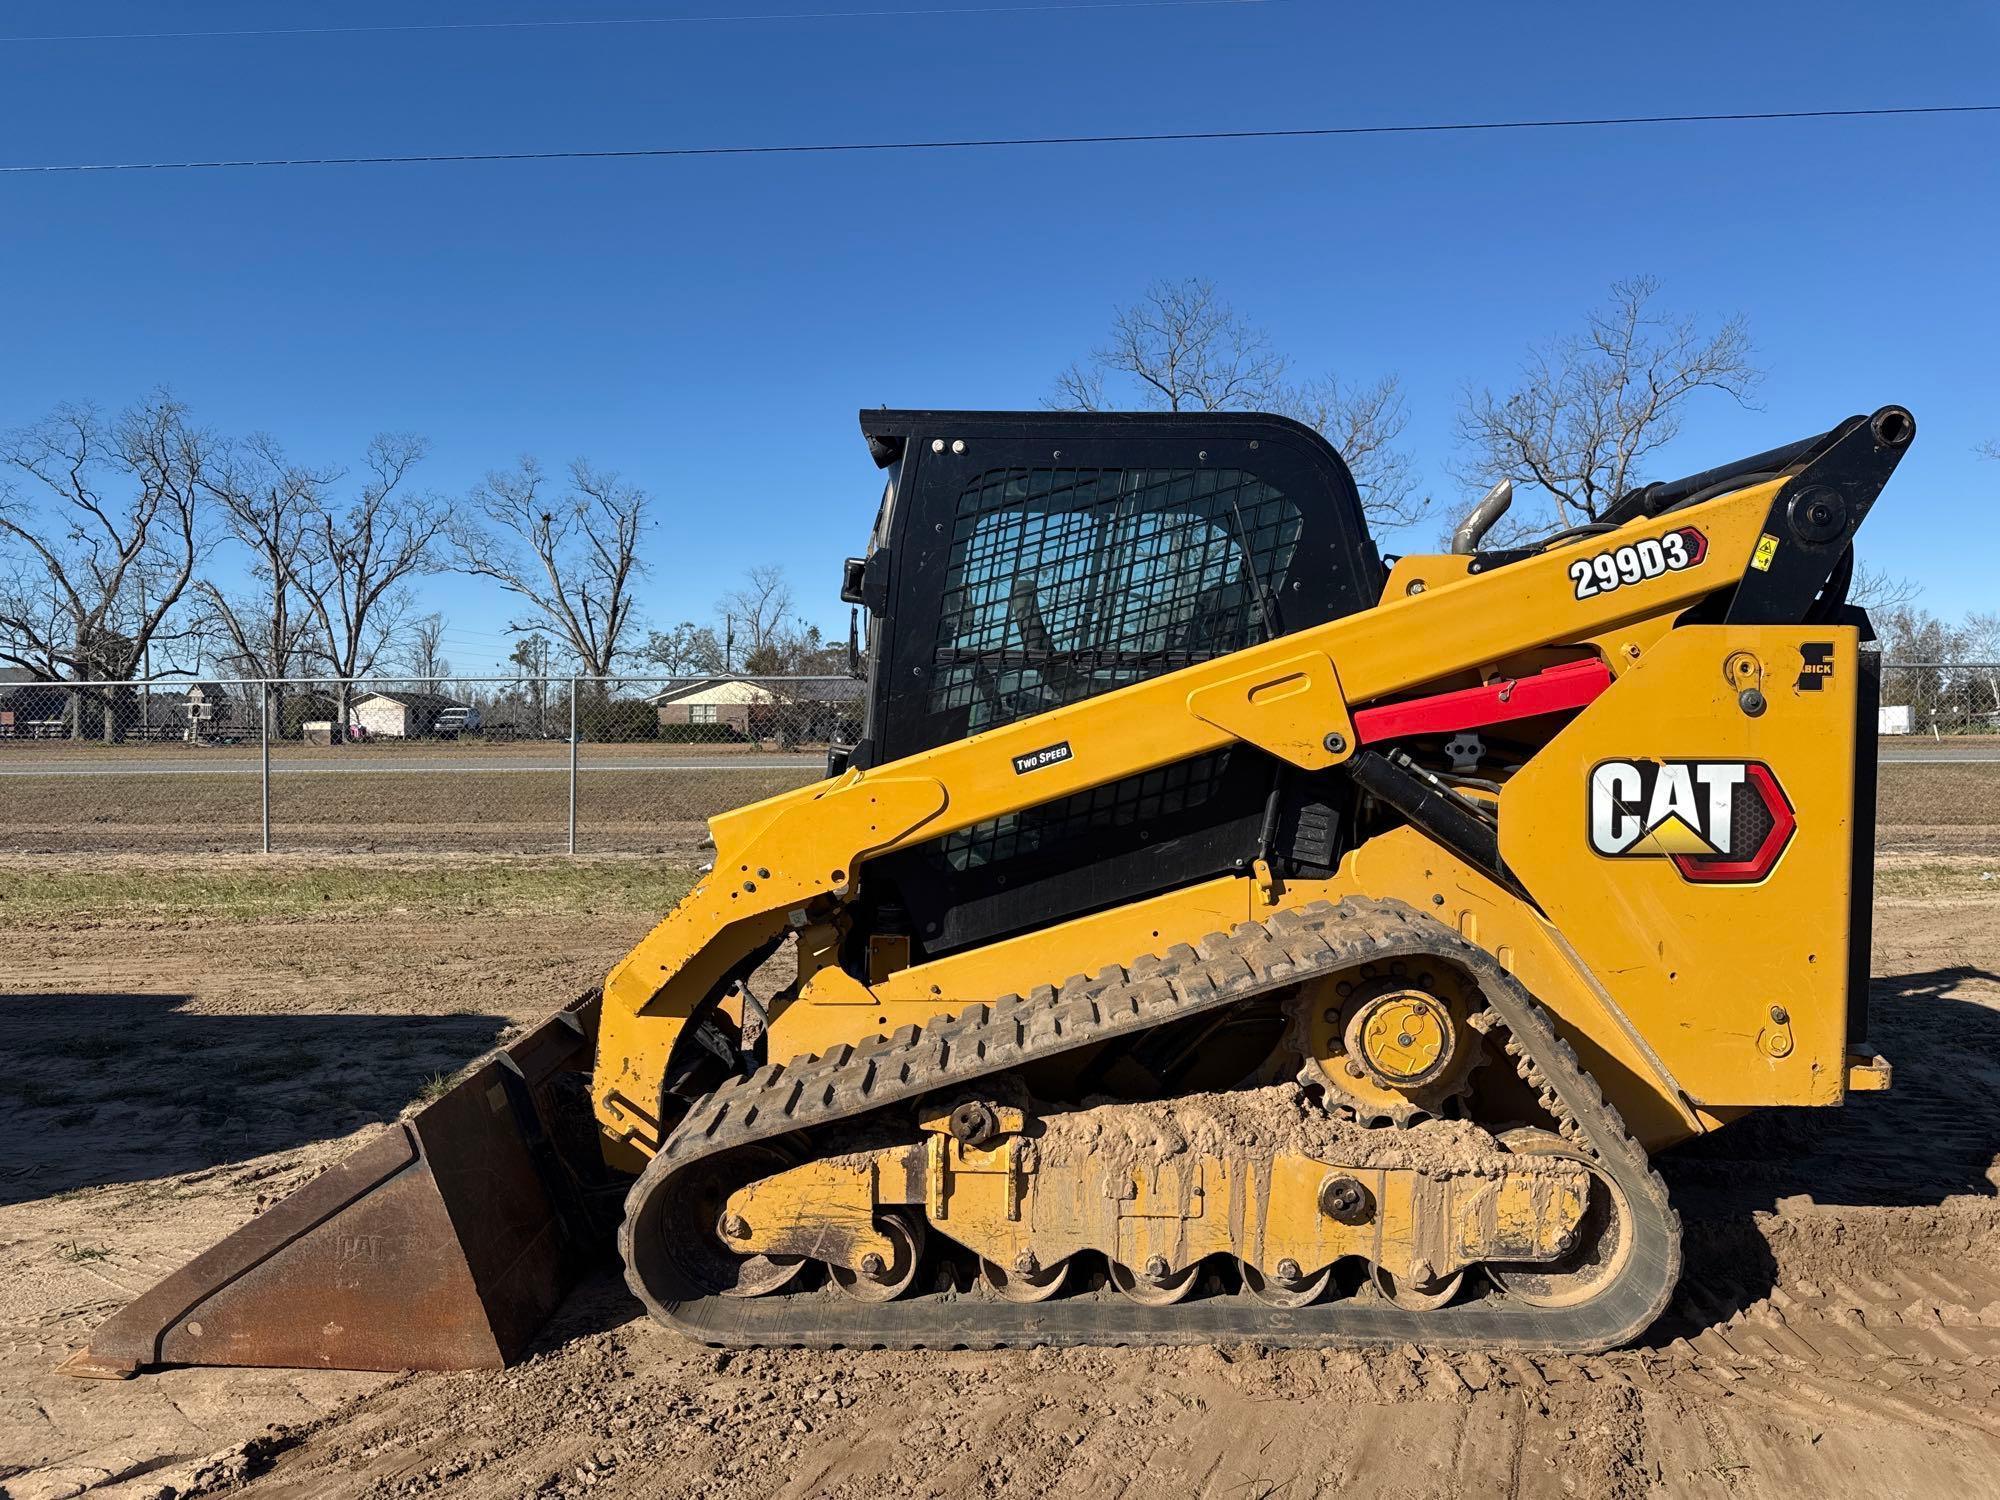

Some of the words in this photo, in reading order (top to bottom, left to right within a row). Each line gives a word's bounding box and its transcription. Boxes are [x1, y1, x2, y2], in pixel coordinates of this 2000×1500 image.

[1571, 533, 1688, 598] 299D3
[1802, 665, 1831, 673] BICK
[1593, 763, 1745, 854] CAT
